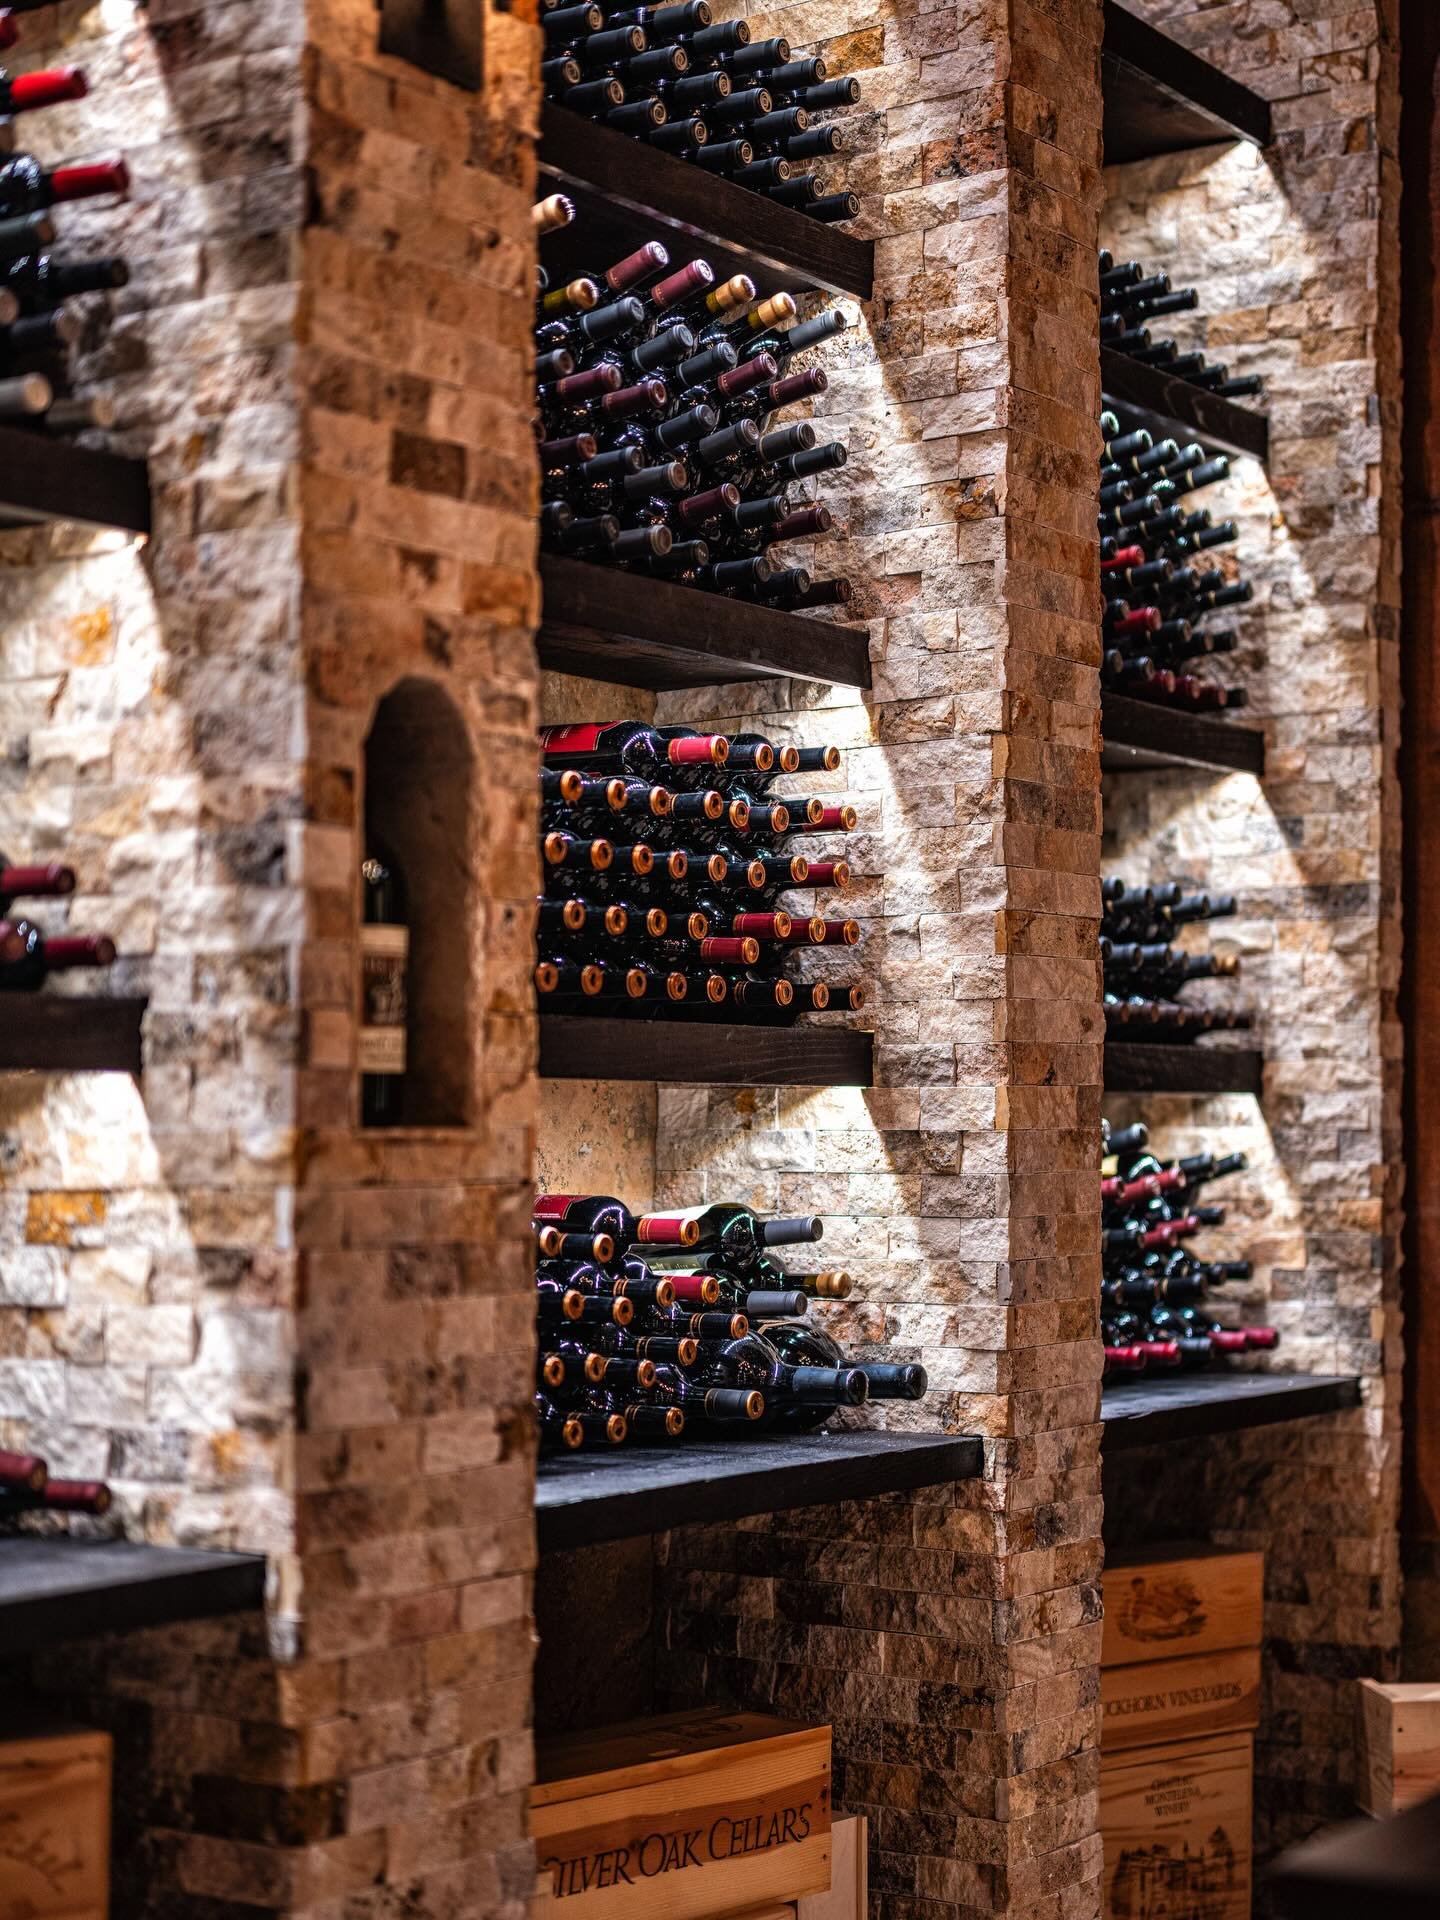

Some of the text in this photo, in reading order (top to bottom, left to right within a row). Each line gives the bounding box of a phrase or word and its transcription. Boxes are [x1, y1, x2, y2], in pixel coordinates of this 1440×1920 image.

[1102, 1693, 1166, 1716] CKHORN
[638, 1829, 705, 1877] OAK
[708, 1803, 812, 1860] CELLARS
